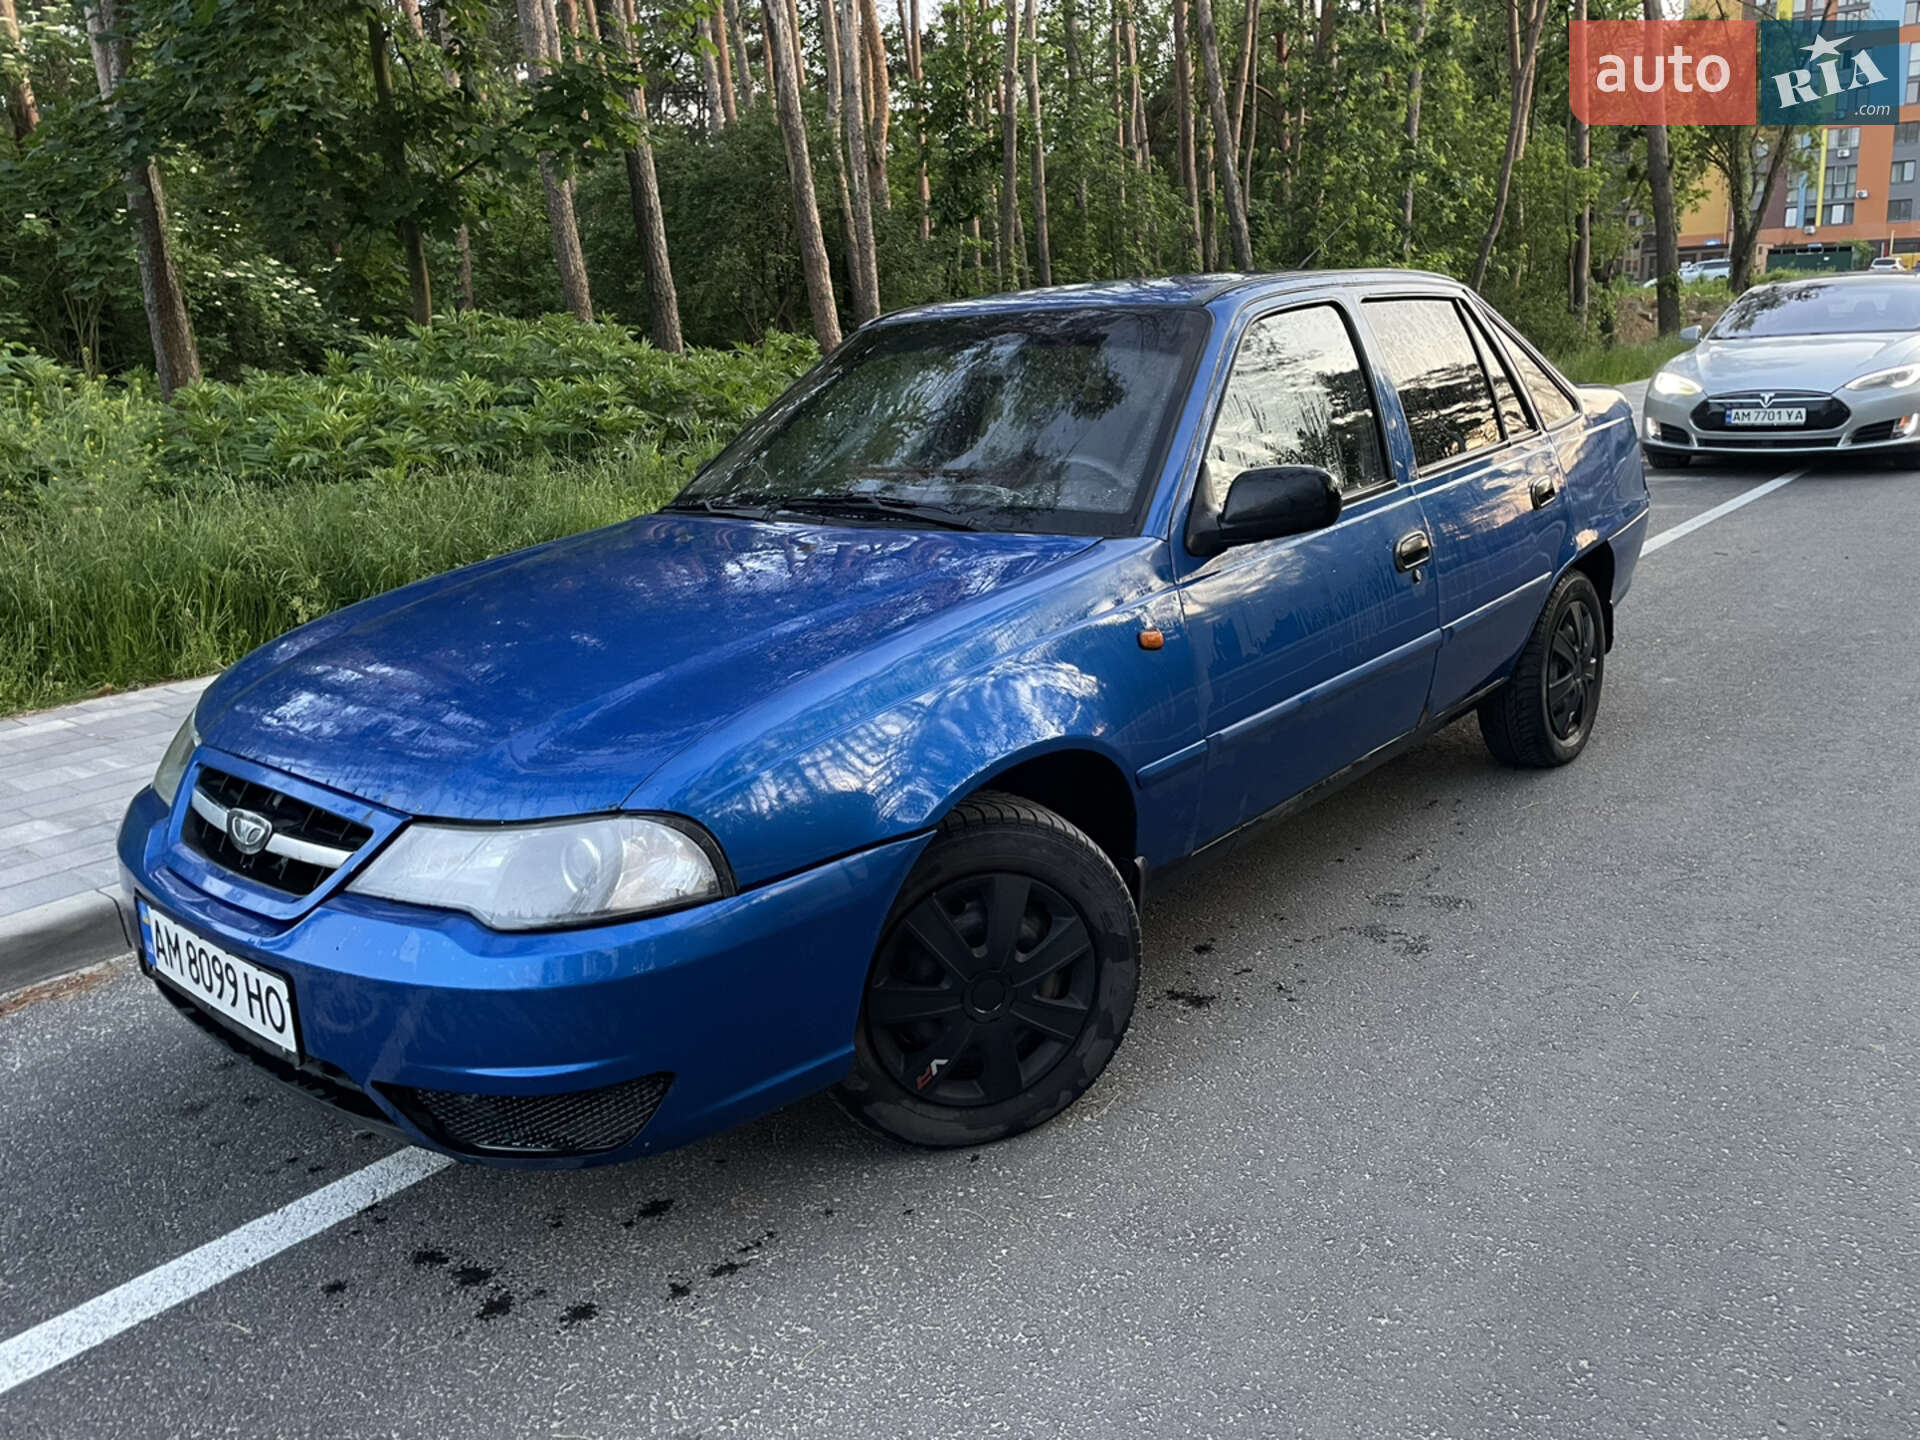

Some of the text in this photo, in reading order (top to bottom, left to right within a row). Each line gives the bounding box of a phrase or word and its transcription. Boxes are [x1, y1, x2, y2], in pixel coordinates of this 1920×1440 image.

[1733, 409, 1804, 422] AM 7701 YA
[154, 919, 286, 1035] AM 8099 HO
